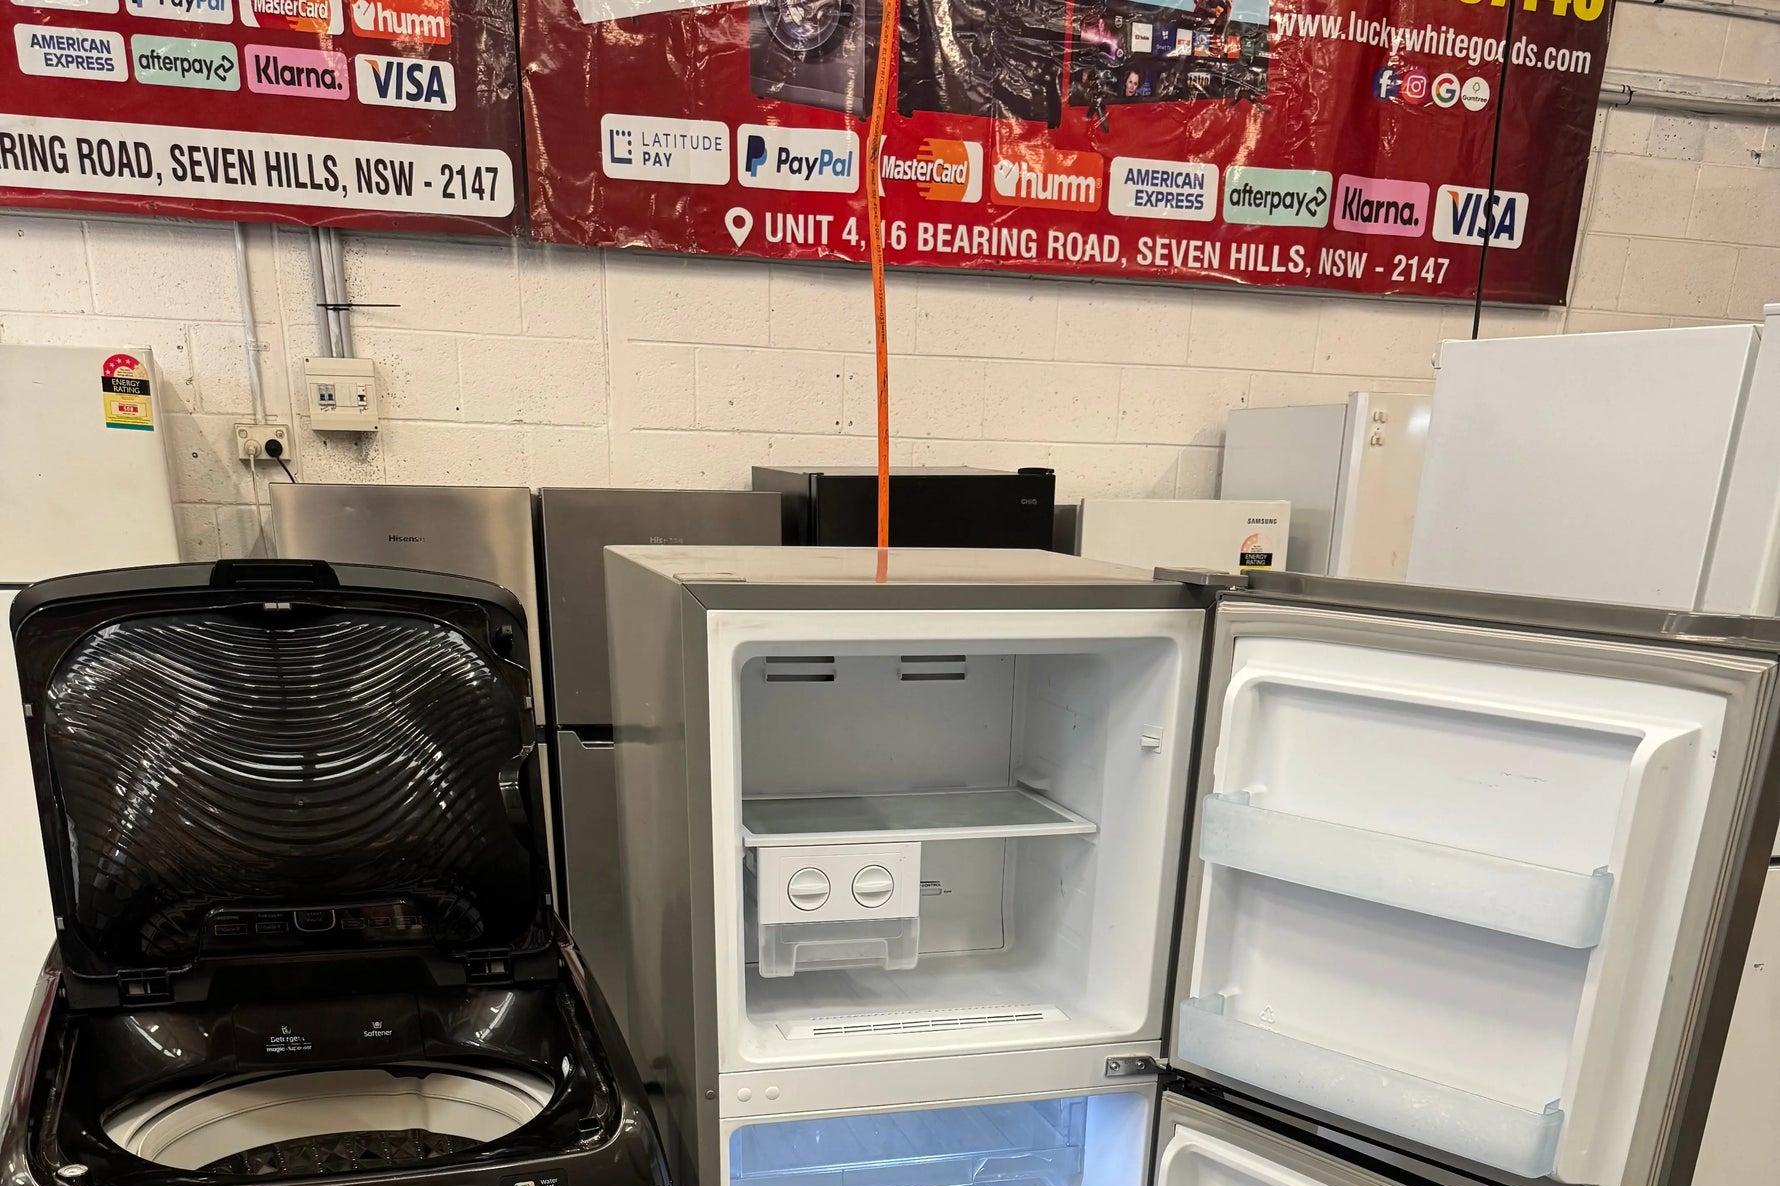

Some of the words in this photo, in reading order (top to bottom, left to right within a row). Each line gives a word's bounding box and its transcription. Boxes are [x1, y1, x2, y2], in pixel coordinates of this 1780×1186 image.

[377, 2, 445, 38] humm
[30, 33, 112, 54] AMERICAN
[43, 52, 115, 72] EXPRESS
[138, 49, 214, 80] afterpay
[254, 54, 343, 91] Klarna.
[364, 59, 448, 104] VISA
[641, 131, 723, 152] LATITUDE
[0, 131, 69, 174] RING
[76, 137, 163, 186] ROAD,
[169, 143, 257, 186] SEVEN
[264, 150, 348, 198] HILLS,
[355, 157, 414, 197] NSW
[440, 163, 499, 201] 2147
[643, 151, 672, 167] PAY
[776, 146, 853, 181] PayPal
[881, 155, 968, 185] MasterCard
[1020, 162, 1095, 203] humm
[1124, 167, 1204, 190] AMERICAN
[1134, 189, 1204, 211] EXPRESS
[1229, 182, 1308, 217] afterpay
[1341, 186, 1419, 227] Klarna.
[1447, 190, 1516, 241] VISA
[764, 211, 834, 246] UNIT
[842, 217, 867, 252] 4,
[917, 223, 1037, 259] BEARING
[1047, 230, 1128, 269] ROAD,
[1136, 236, 1221, 270] SEVEN
[1229, 242, 1311, 278] HILLS,
[1318, 247, 1368, 279] NSW
[1391, 254, 1450, 284] 2147
[111, 378, 140, 387] ENERGY
[113, 385, 140, 394] RATING
[363, 1030, 393, 1038] Softener
